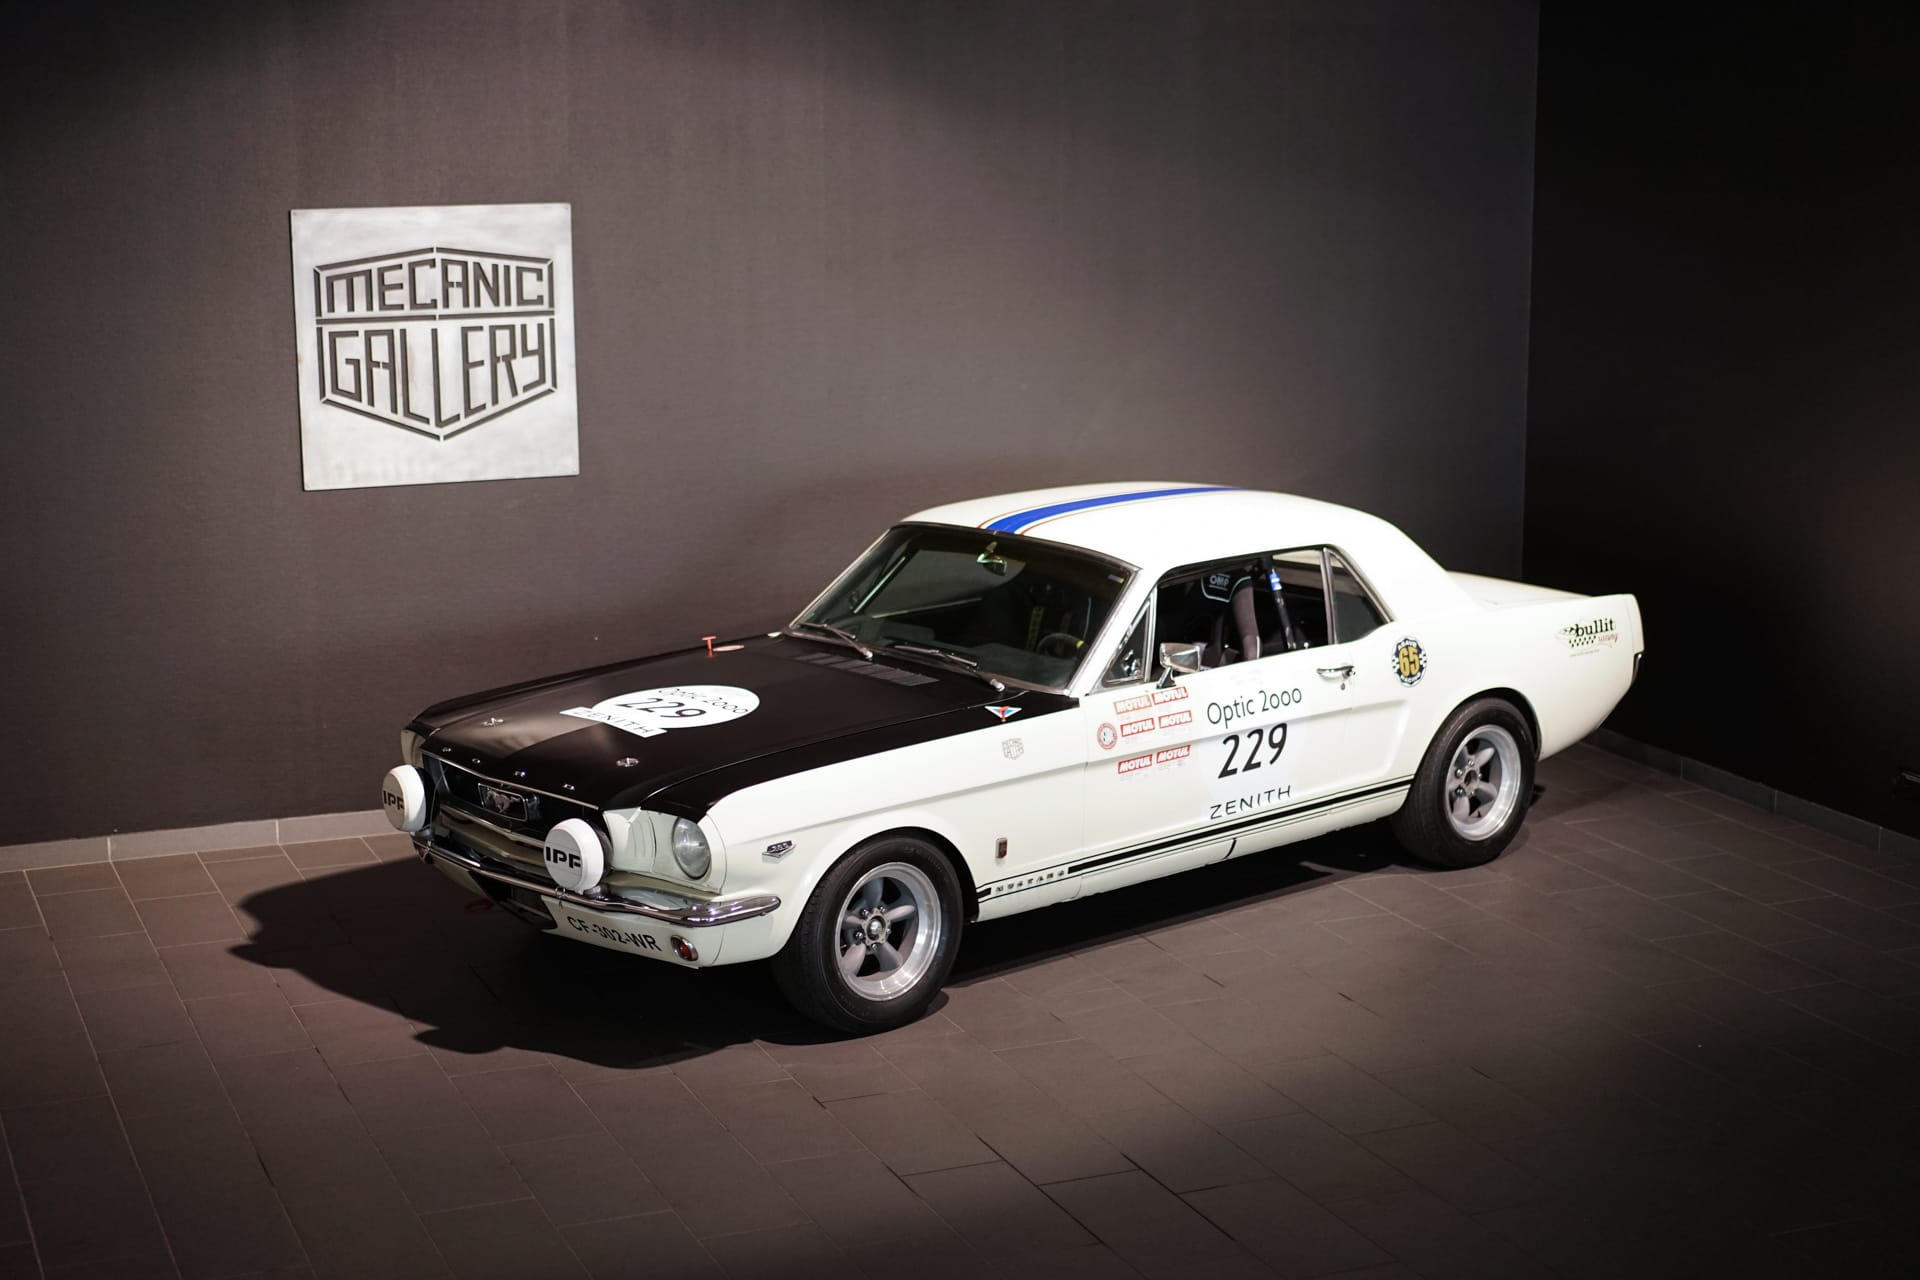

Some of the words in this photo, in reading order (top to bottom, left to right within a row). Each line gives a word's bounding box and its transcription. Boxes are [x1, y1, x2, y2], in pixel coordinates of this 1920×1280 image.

[326, 258, 544, 313] MECANIC
[328, 323, 546, 428] GALLERY
[1575, 617, 1615, 638] bullit
[1399, 646, 1420, 677] 65
[702, 696, 749, 713] 2000
[1117, 695, 1150, 712] MOTUL
[1154, 688, 1187, 704] MOTUL
[615, 697, 707, 718] 229
[1207, 695, 1255, 729] Optic
[1259, 688, 1302, 712] 2000
[573, 709, 655, 734] ZENITH
[1122, 721, 1154, 736] MOTUL
[1160, 712, 1191, 727] MOTUL
[1157, 747, 1189, 762] MOTUL
[1217, 722, 1288, 779] 229
[1119, 756, 1152, 772] MOTUL
[383, 790, 405, 810] IPF
[1210, 785, 1291, 820] ZENITH
[546, 846, 582, 869] IPF
[567, 916, 661, 952] CF-302-WR
